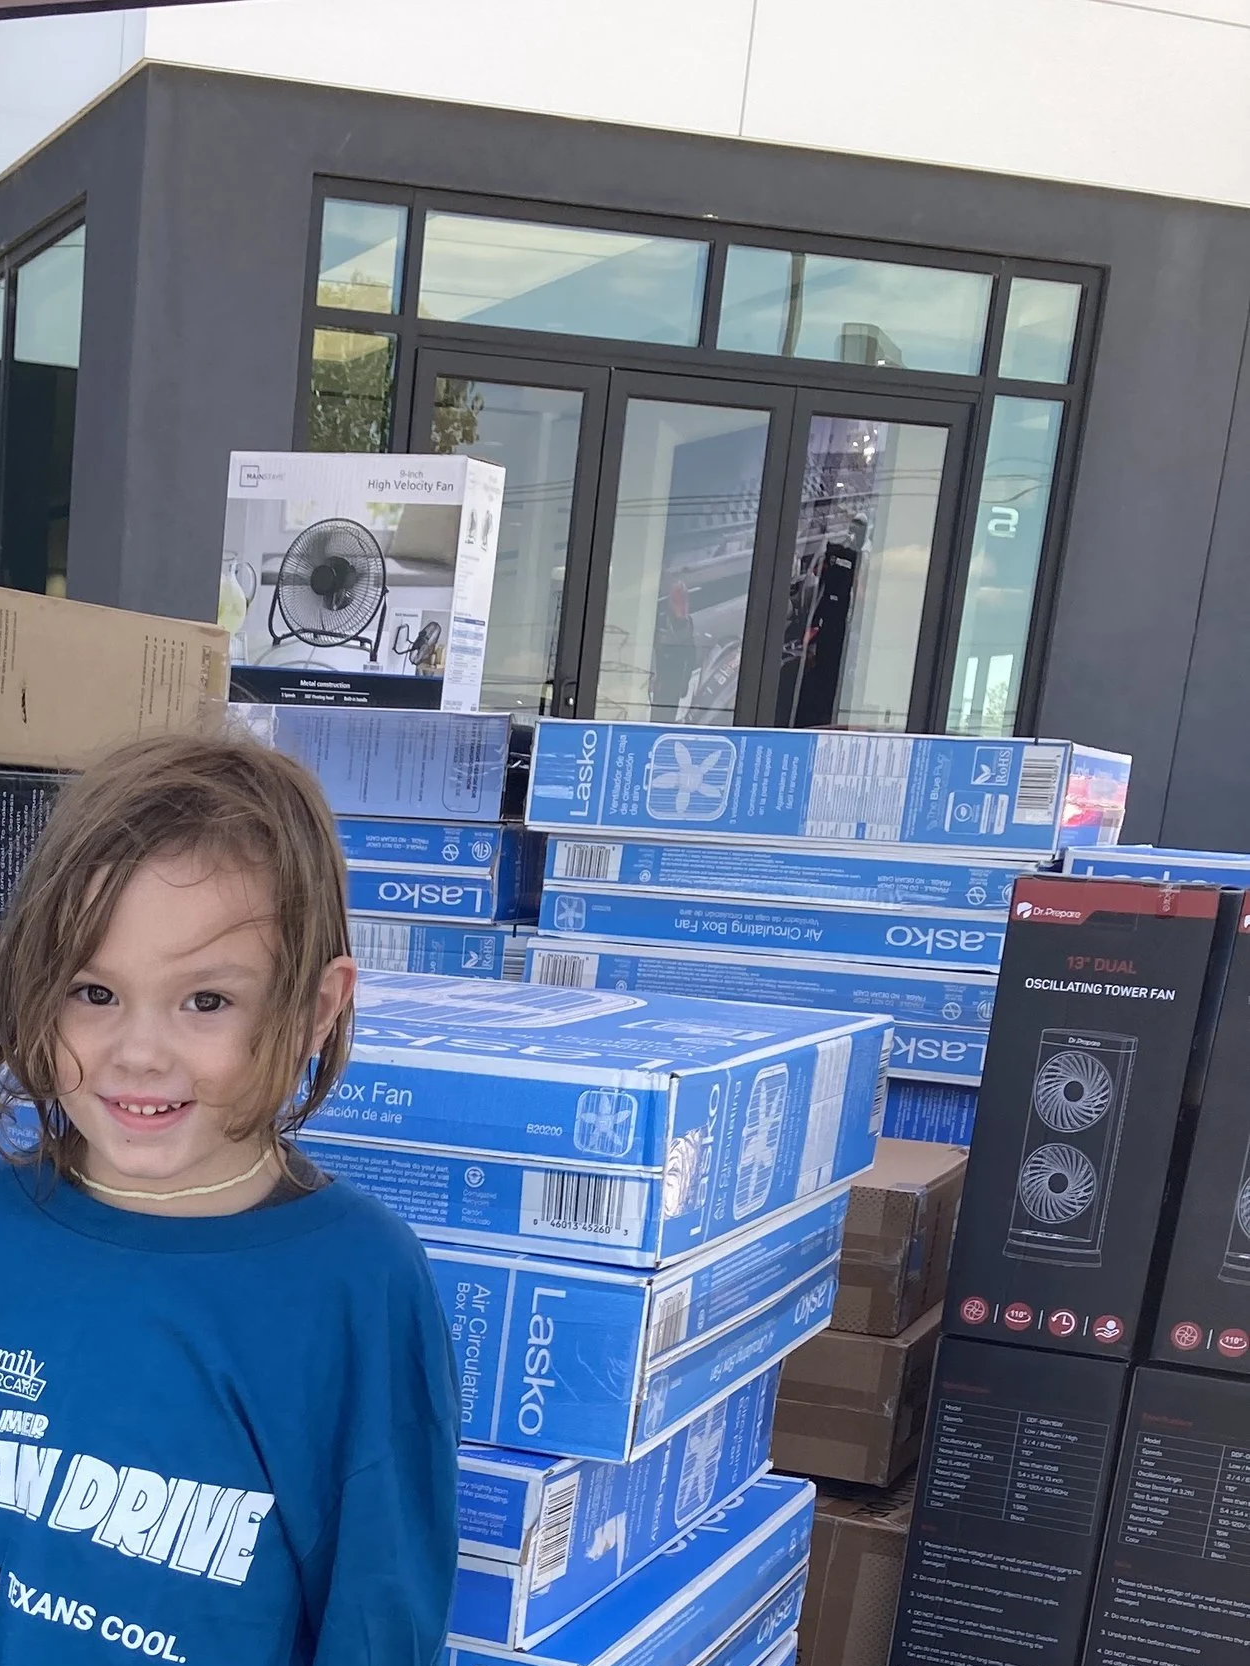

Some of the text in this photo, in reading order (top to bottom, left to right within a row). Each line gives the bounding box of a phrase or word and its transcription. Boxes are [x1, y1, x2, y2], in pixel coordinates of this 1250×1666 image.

[367, 480, 454, 492] High Velocity Fan
[400, 470, 424, 479] 9-inch
[317, 681, 351, 689] construction
[570, 730, 597, 817] Lasko
[610, 735, 627, 815] Ventilador de caja
[622, 753, 634, 803] circulación
[995, 749, 1011, 784] RoHS
[379, 882, 482, 912] Lasko
[674, 918, 823, 943] Air Circulating Box Fan
[886, 926, 1005, 956] Lasko
[482, 938, 495, 970] RoHS
[1094, 958, 1137, 974] DUAL
[1025, 978, 1175, 1001] OSCILLATING TOWER FAN
[372, 1081, 413, 1107] Fan
[526, 1123, 563, 1137] B20200
[550, 1218, 612, 1235] 46013 45260
[1010, 1309, 1027, 1319] 110°
[517, 1286, 567, 1437] Lasko
[48, 1453, 276, 1586] DRIVE
[101, 1614, 187, 1664] COOL.
